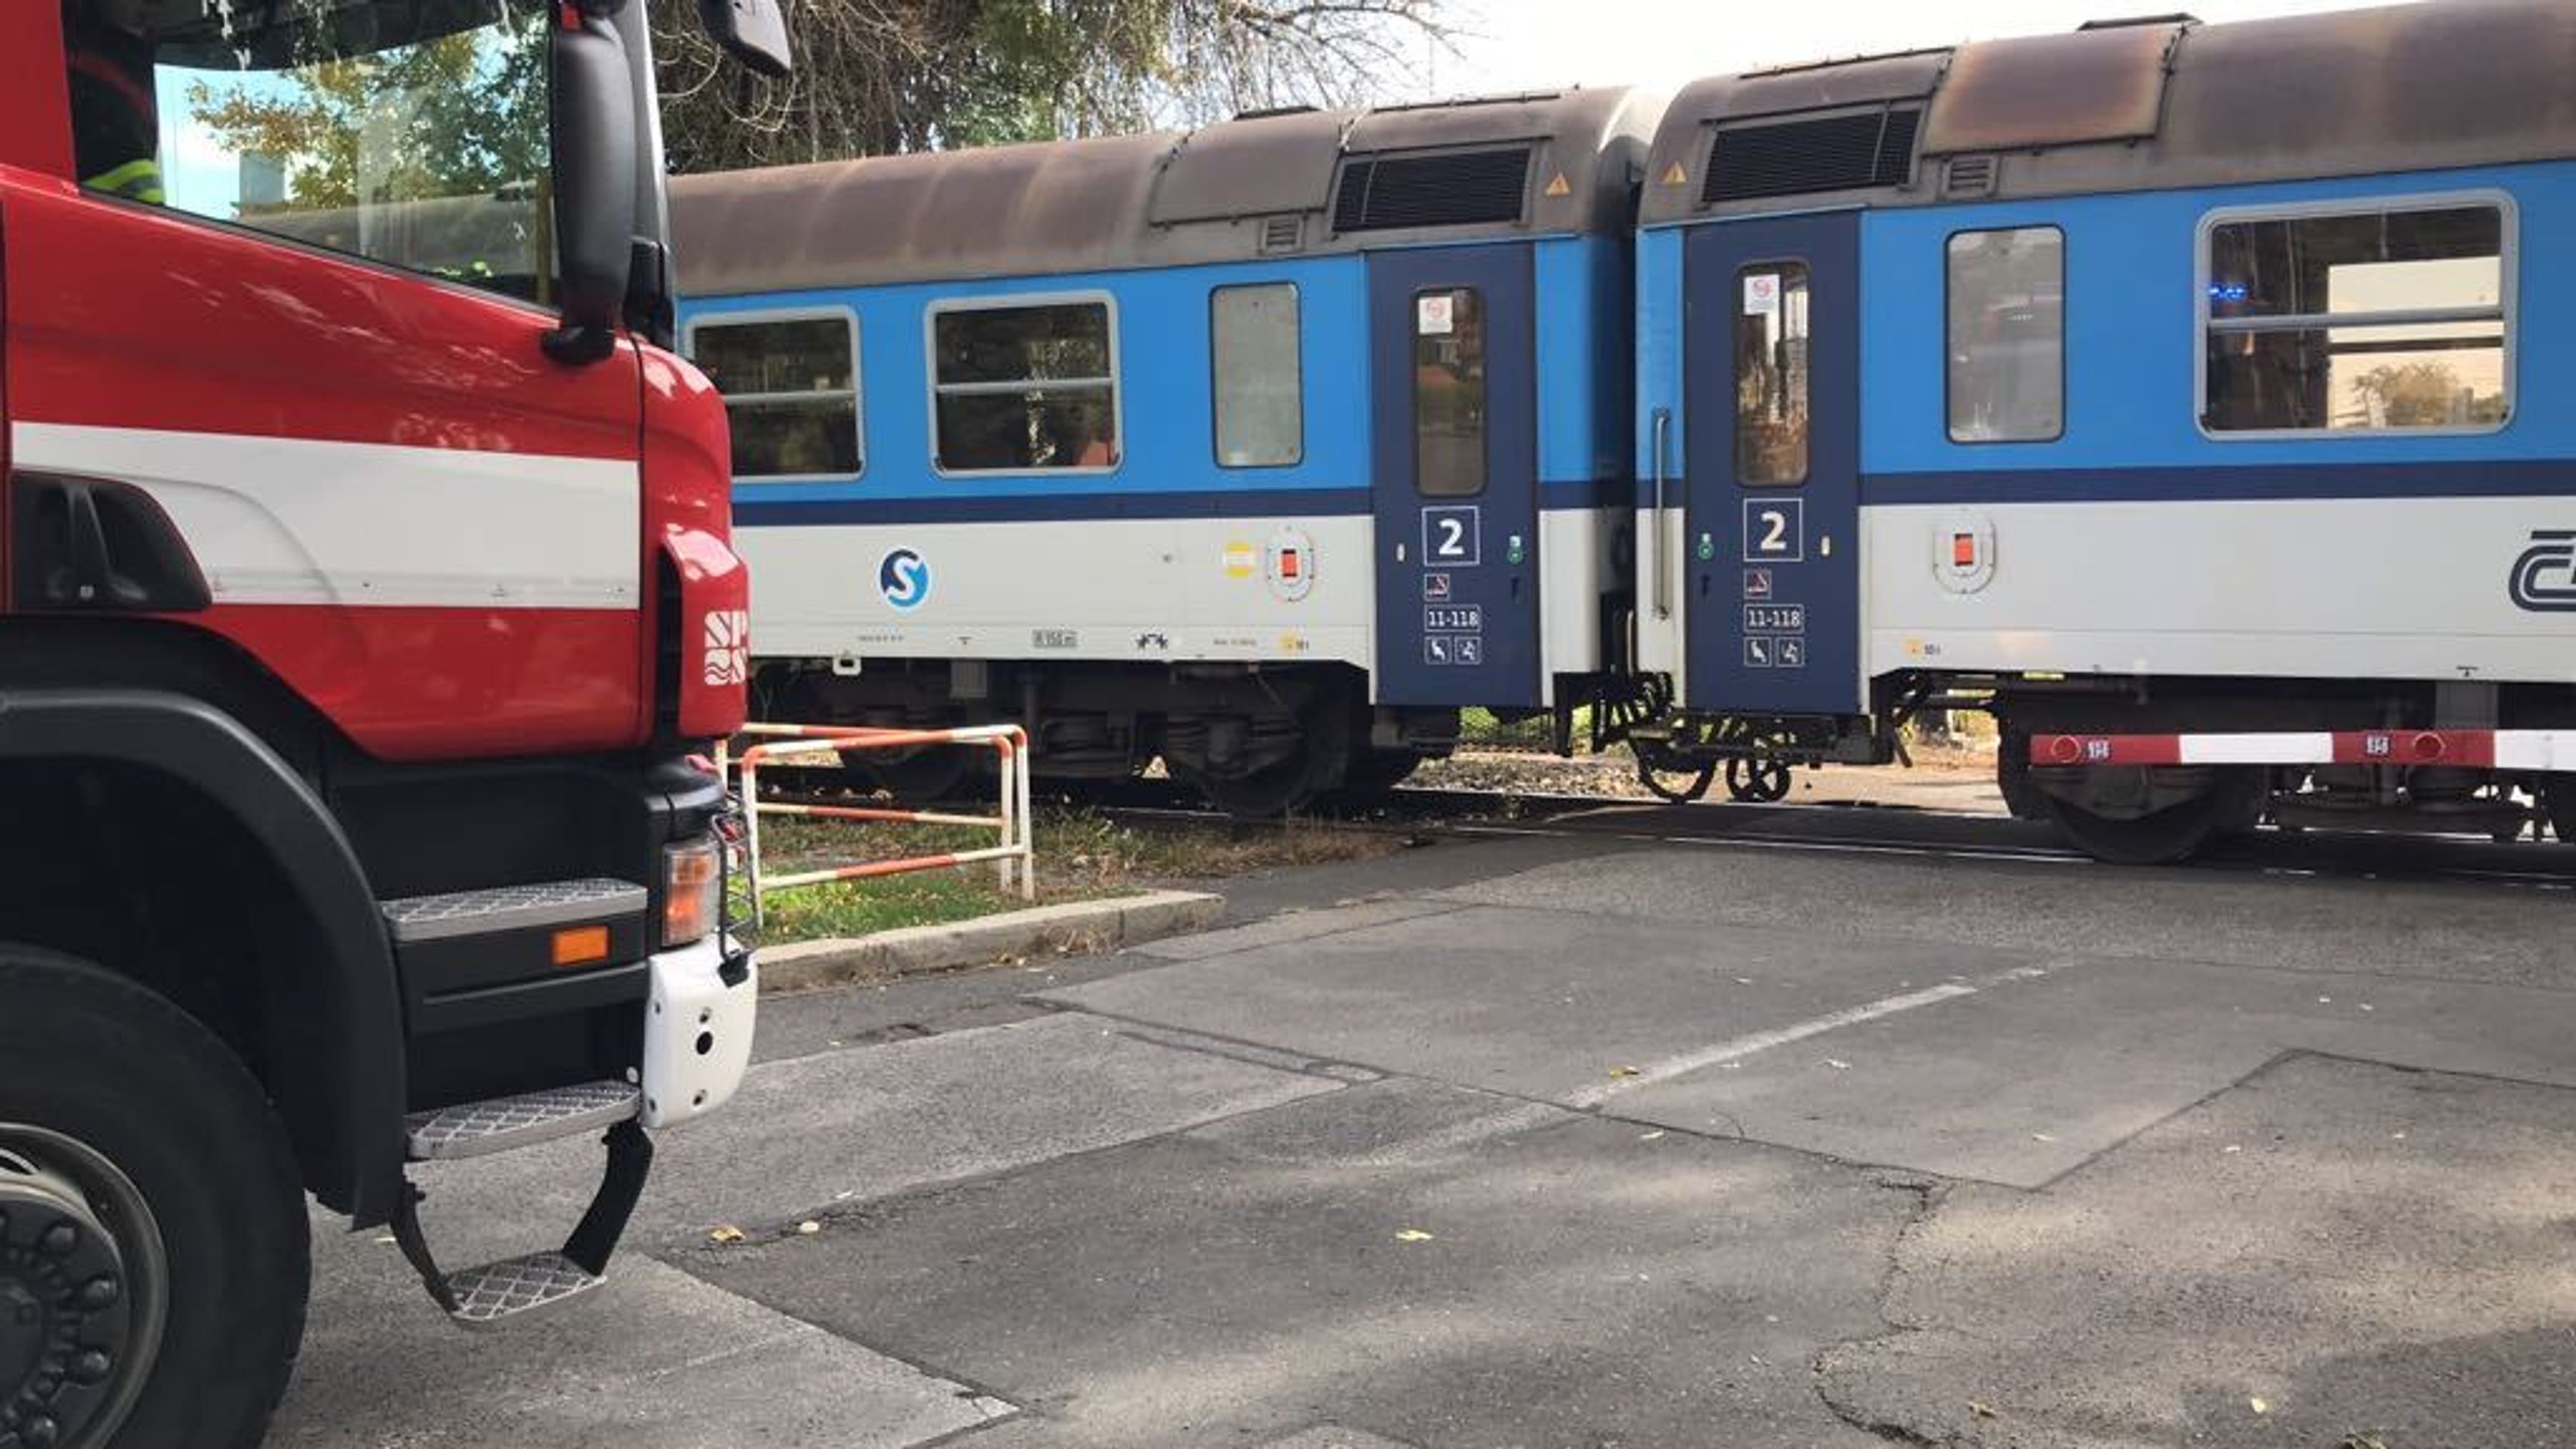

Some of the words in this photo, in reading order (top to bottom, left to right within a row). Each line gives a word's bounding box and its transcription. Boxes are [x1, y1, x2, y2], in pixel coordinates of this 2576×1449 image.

[1439, 518, 1465, 555] 2
[1760, 510, 1787, 550] 2
[1428, 610, 1479, 628] 11-118
[1747, 609, 1801, 628] 11-118
